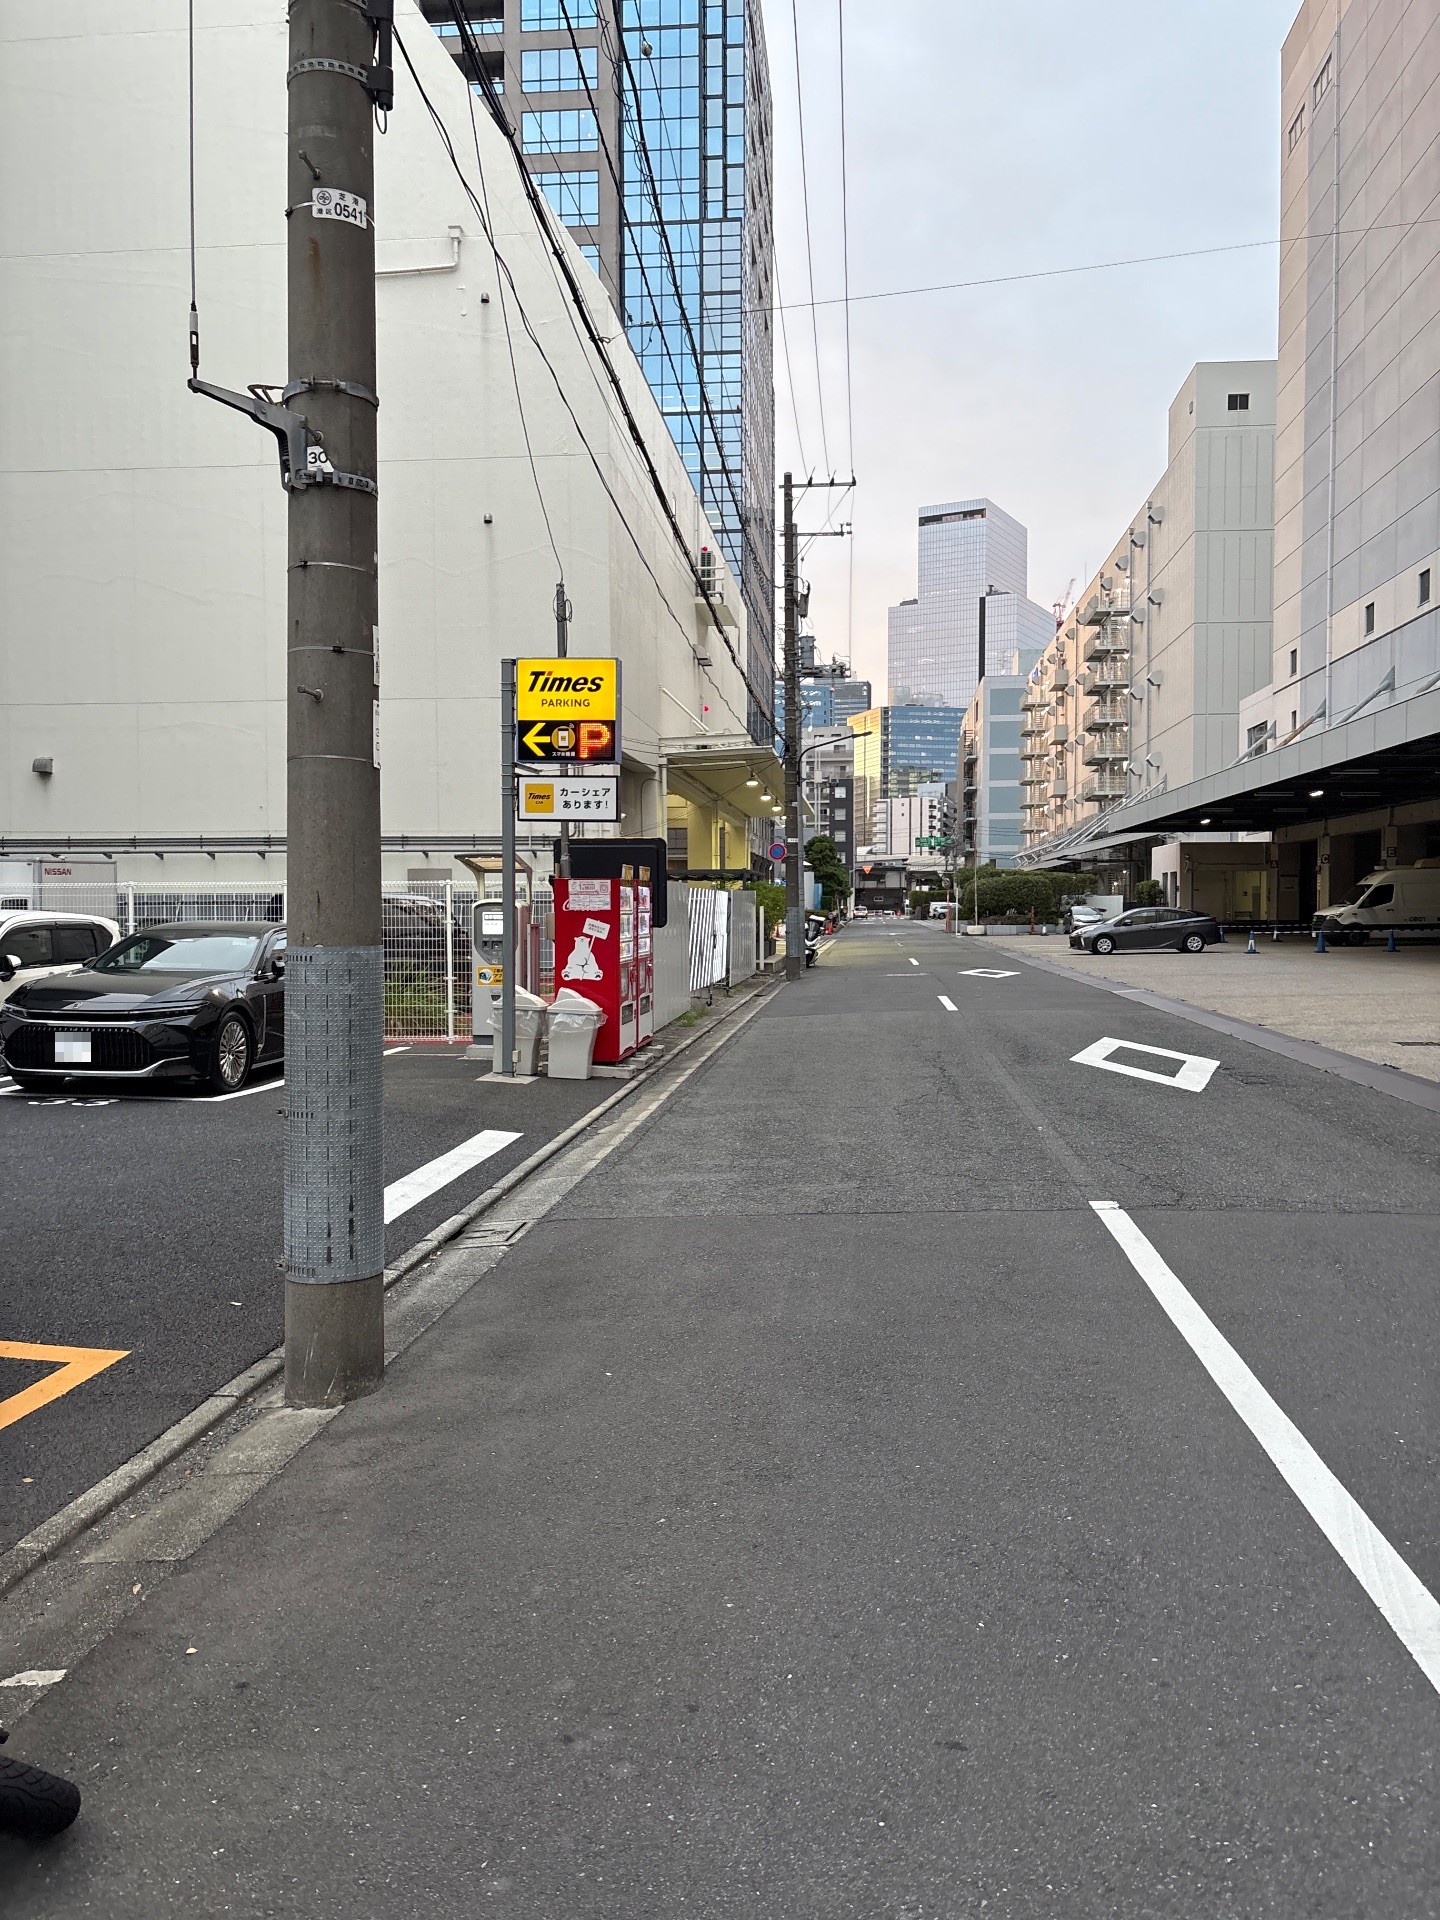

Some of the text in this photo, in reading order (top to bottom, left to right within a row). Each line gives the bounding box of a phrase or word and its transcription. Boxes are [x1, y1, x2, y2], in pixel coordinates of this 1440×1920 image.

[335, 203, 363, 224] 0541
[528, 670, 604, 693] Times
[541, 698, 591, 708] PARKING
[579, 722, 611, 759] P
[528, 792, 551, 800] Times
[560, 787, 611, 797] カーシェア
